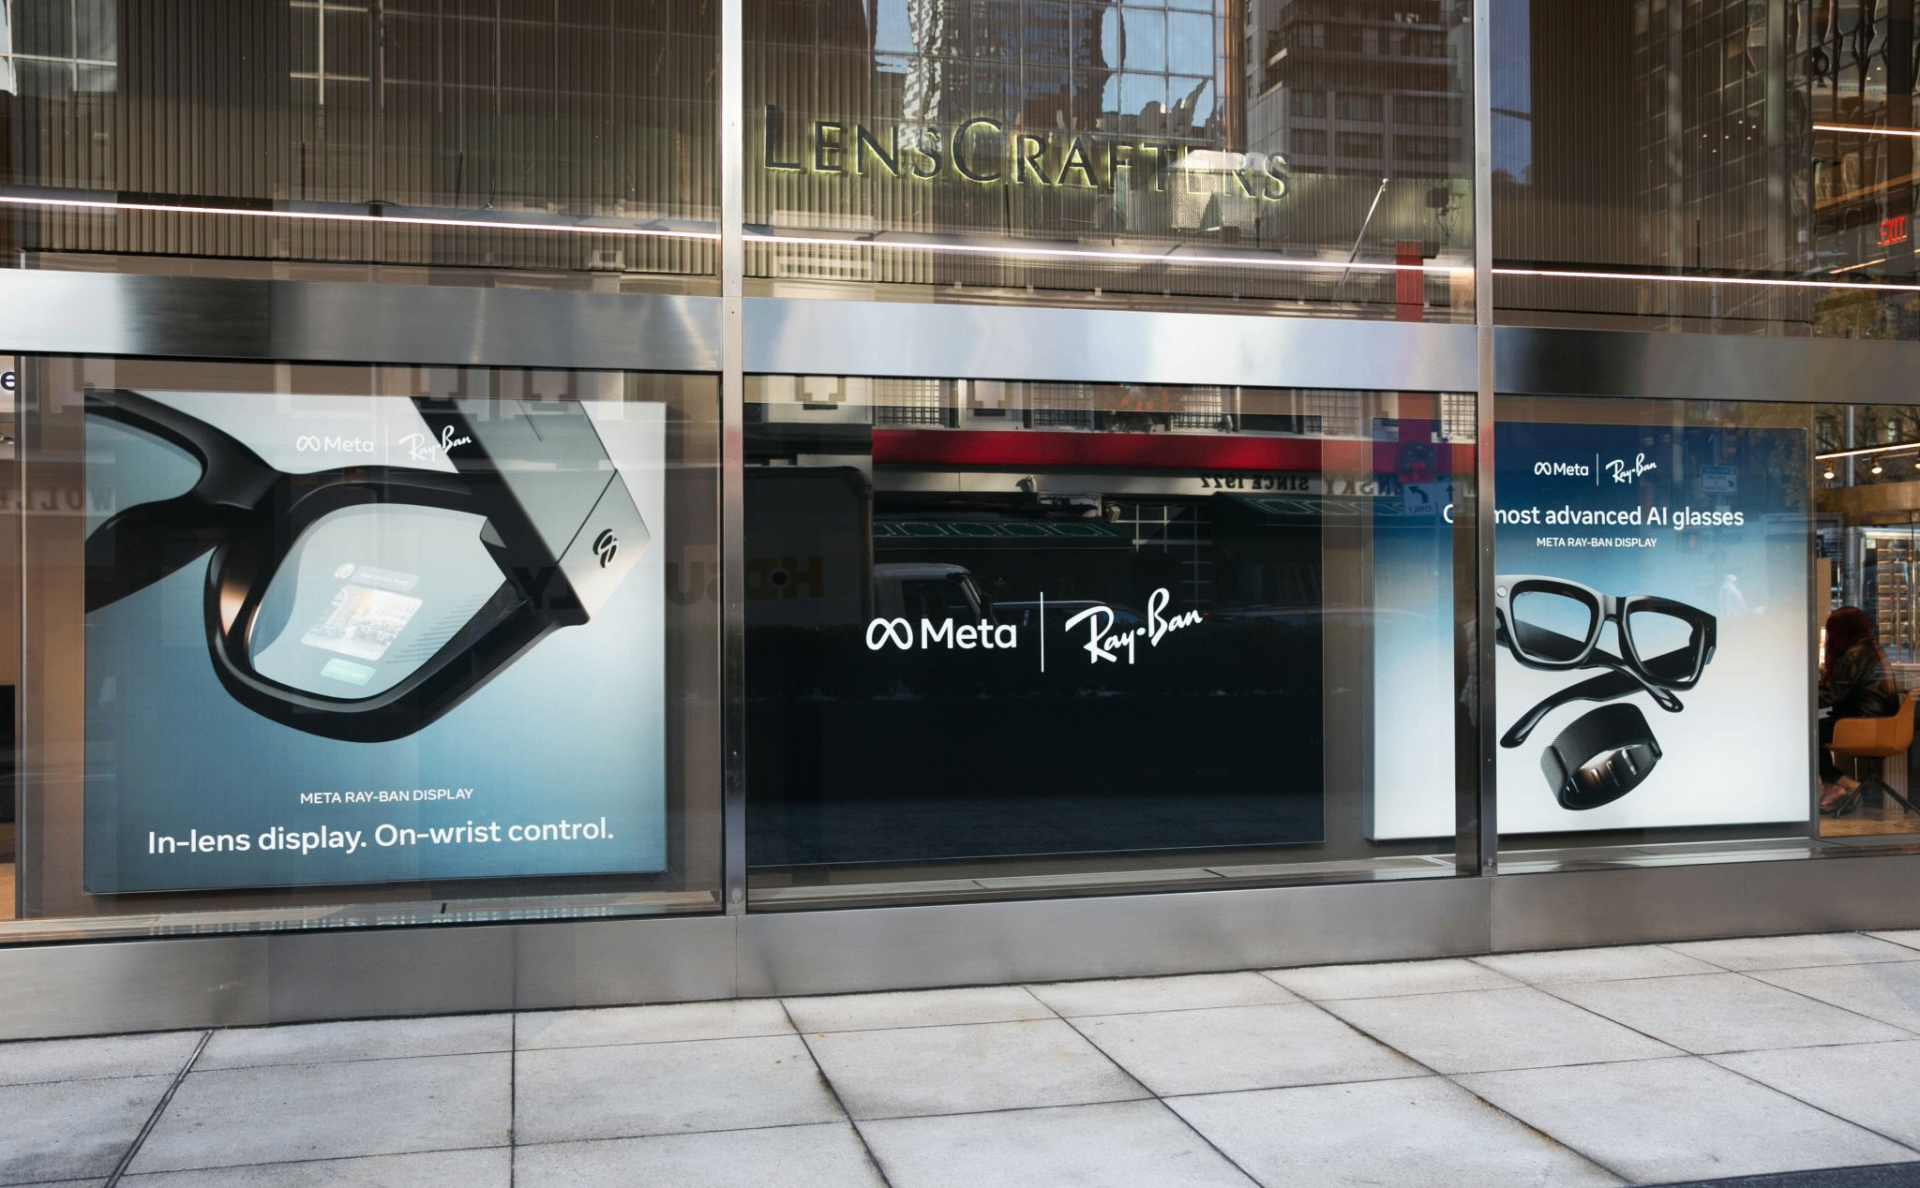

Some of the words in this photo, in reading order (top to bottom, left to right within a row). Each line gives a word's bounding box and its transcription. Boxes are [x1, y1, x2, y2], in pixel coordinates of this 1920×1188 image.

[324, 436, 374, 452] Meta
[1553, 462, 1589, 476] Meta
[1494, 506, 1541, 525] most
[1545, 505, 1642, 526] advanced
[1646, 506, 1667, 526] AI
[1672, 506, 1744, 531] glasses
[1536, 537, 1566, 547] META
[1567, 537, 1613, 548] RAY-BAN
[1614, 537, 1658, 548] DISPLAY
[920, 617, 1018, 650] Meta
[300, 791, 342, 804] META
[345, 789, 409, 803] RAY-BAN
[412, 787, 474, 801] DISPLAY
[149, 828, 251, 854] In-lens
[258, 824, 367, 855] display.
[374, 819, 502, 848] On-wrist
[507, 816, 615, 843] control.
